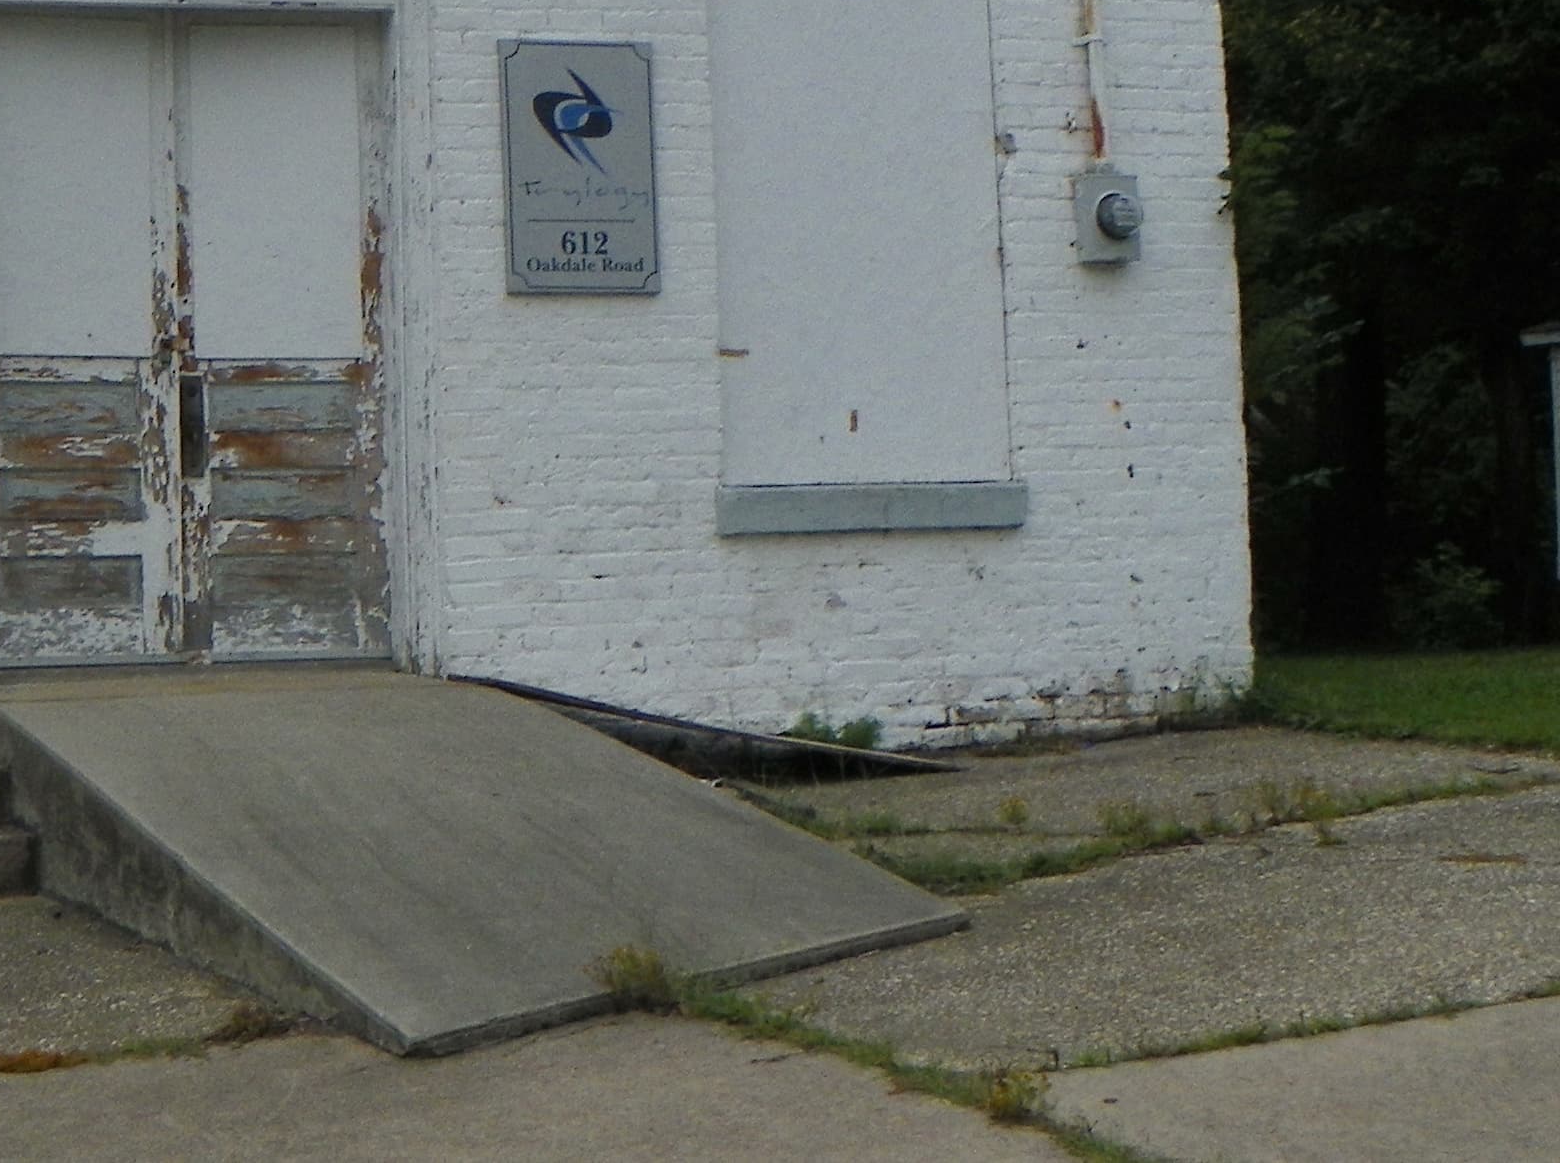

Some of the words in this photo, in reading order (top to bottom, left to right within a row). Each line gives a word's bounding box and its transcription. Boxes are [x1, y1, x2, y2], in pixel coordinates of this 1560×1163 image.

[561, 230, 609, 255] 612
[526, 257, 596, 272] Oakdale
[602, 257, 644, 272] Road
